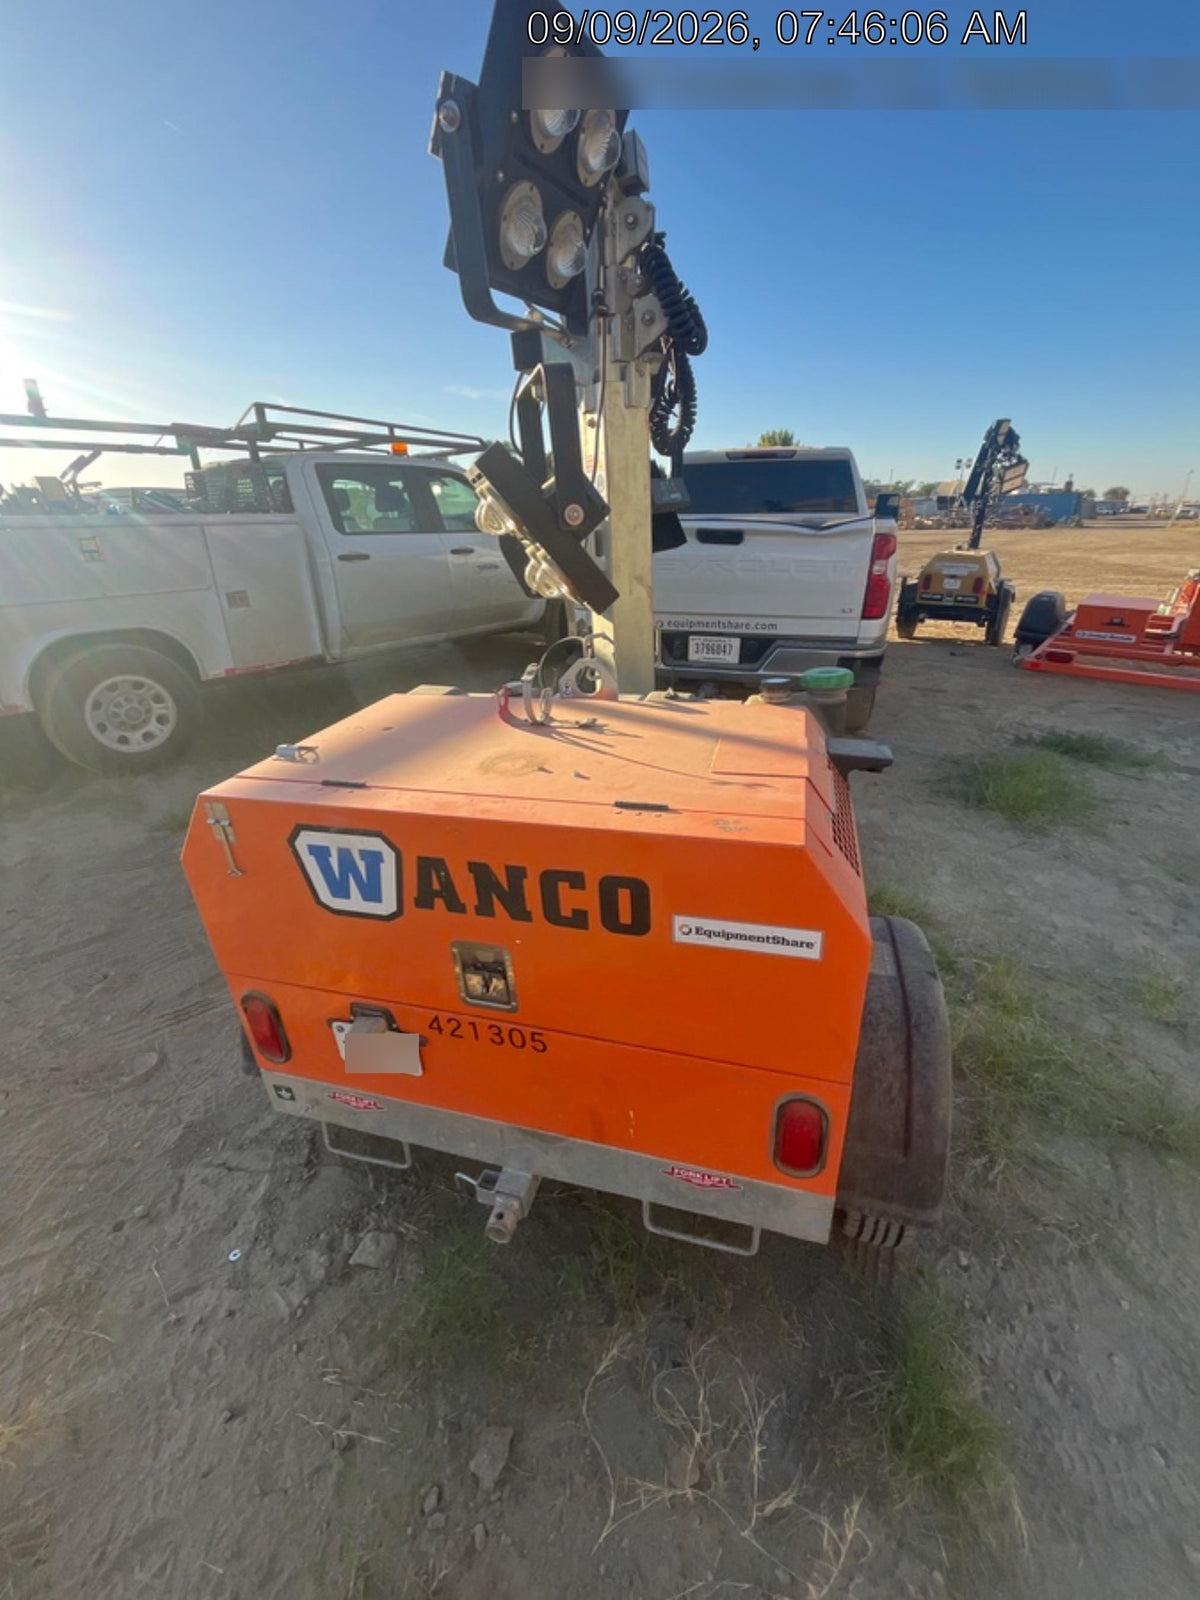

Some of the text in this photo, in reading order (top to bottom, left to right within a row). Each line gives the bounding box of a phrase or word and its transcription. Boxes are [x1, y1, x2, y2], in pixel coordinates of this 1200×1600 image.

[667, 619, 778, 631] equipmentshare.com
[306, 843, 651, 937] WANCO
[694, 925, 815, 950] EquipmentShare
[428, 1015, 548, 1053] 421305
